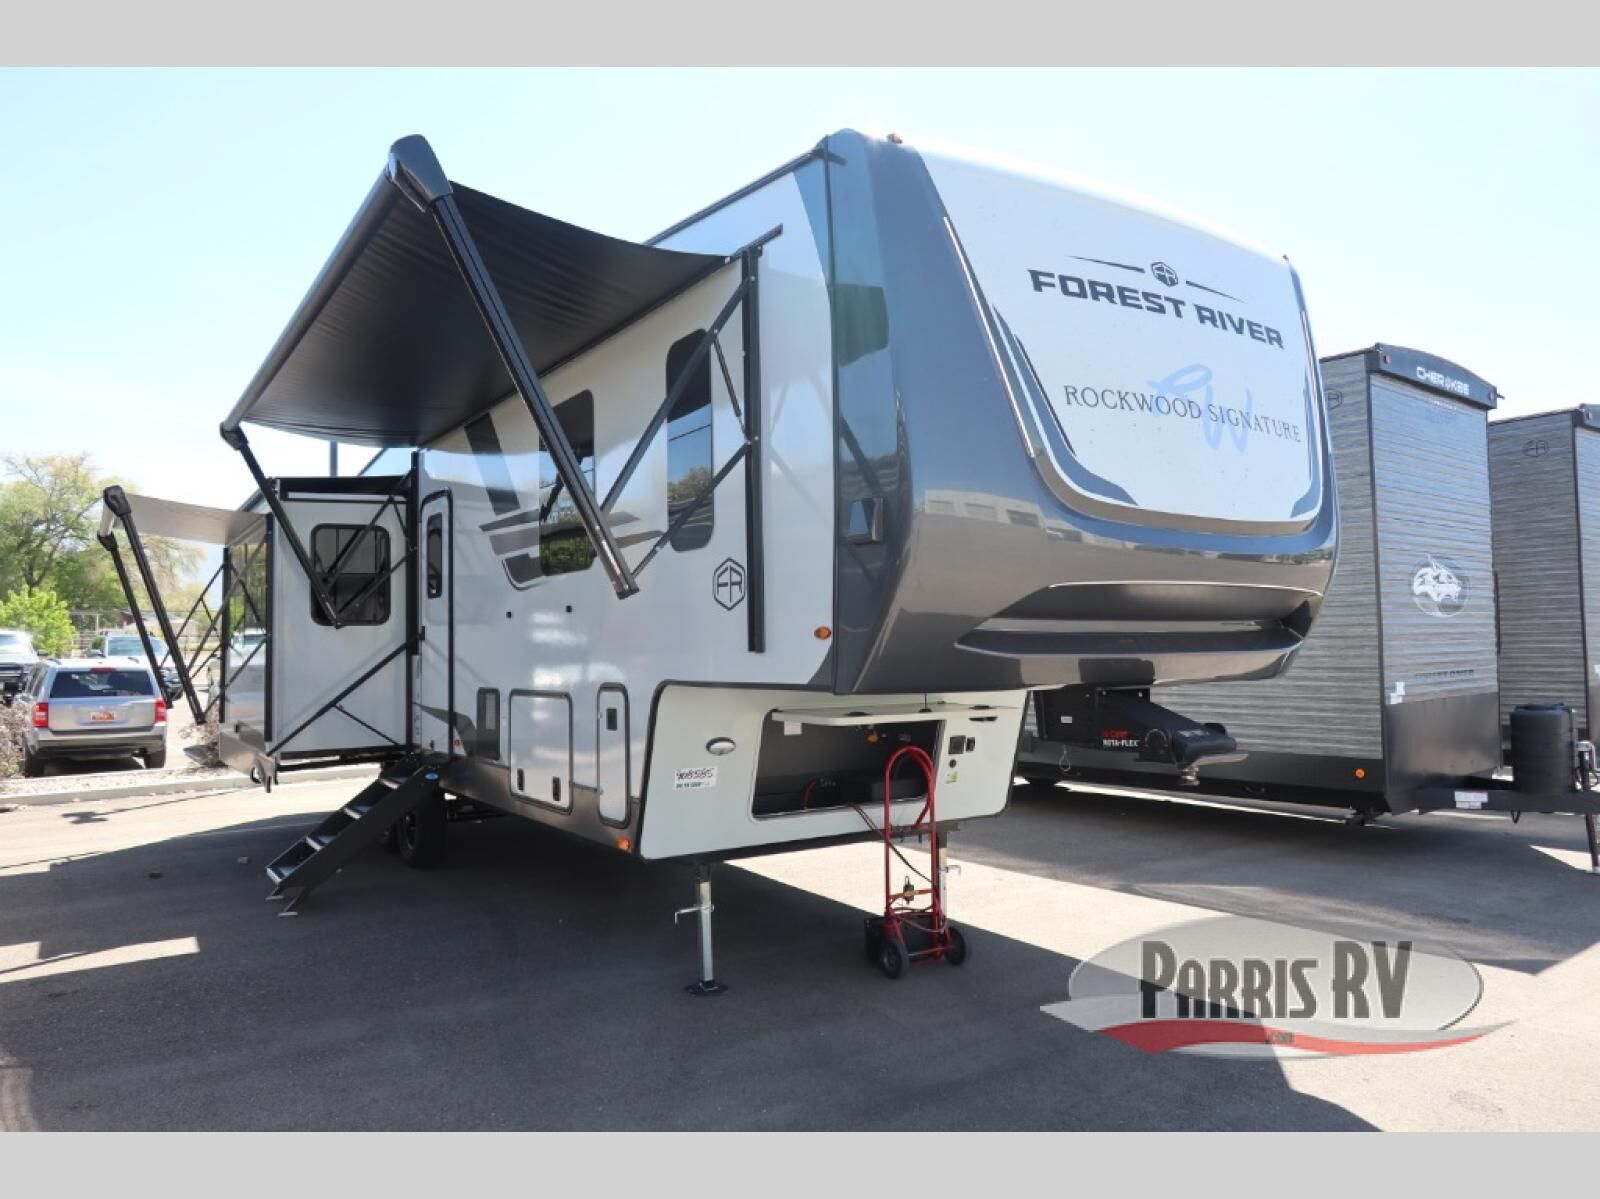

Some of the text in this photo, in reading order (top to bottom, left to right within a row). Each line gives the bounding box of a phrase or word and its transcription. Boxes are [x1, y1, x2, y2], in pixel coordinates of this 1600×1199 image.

[1028, 269, 1285, 350] FOREST RIVER
[1064, 385, 1302, 442] ROCKWOOD SIGNATURE
